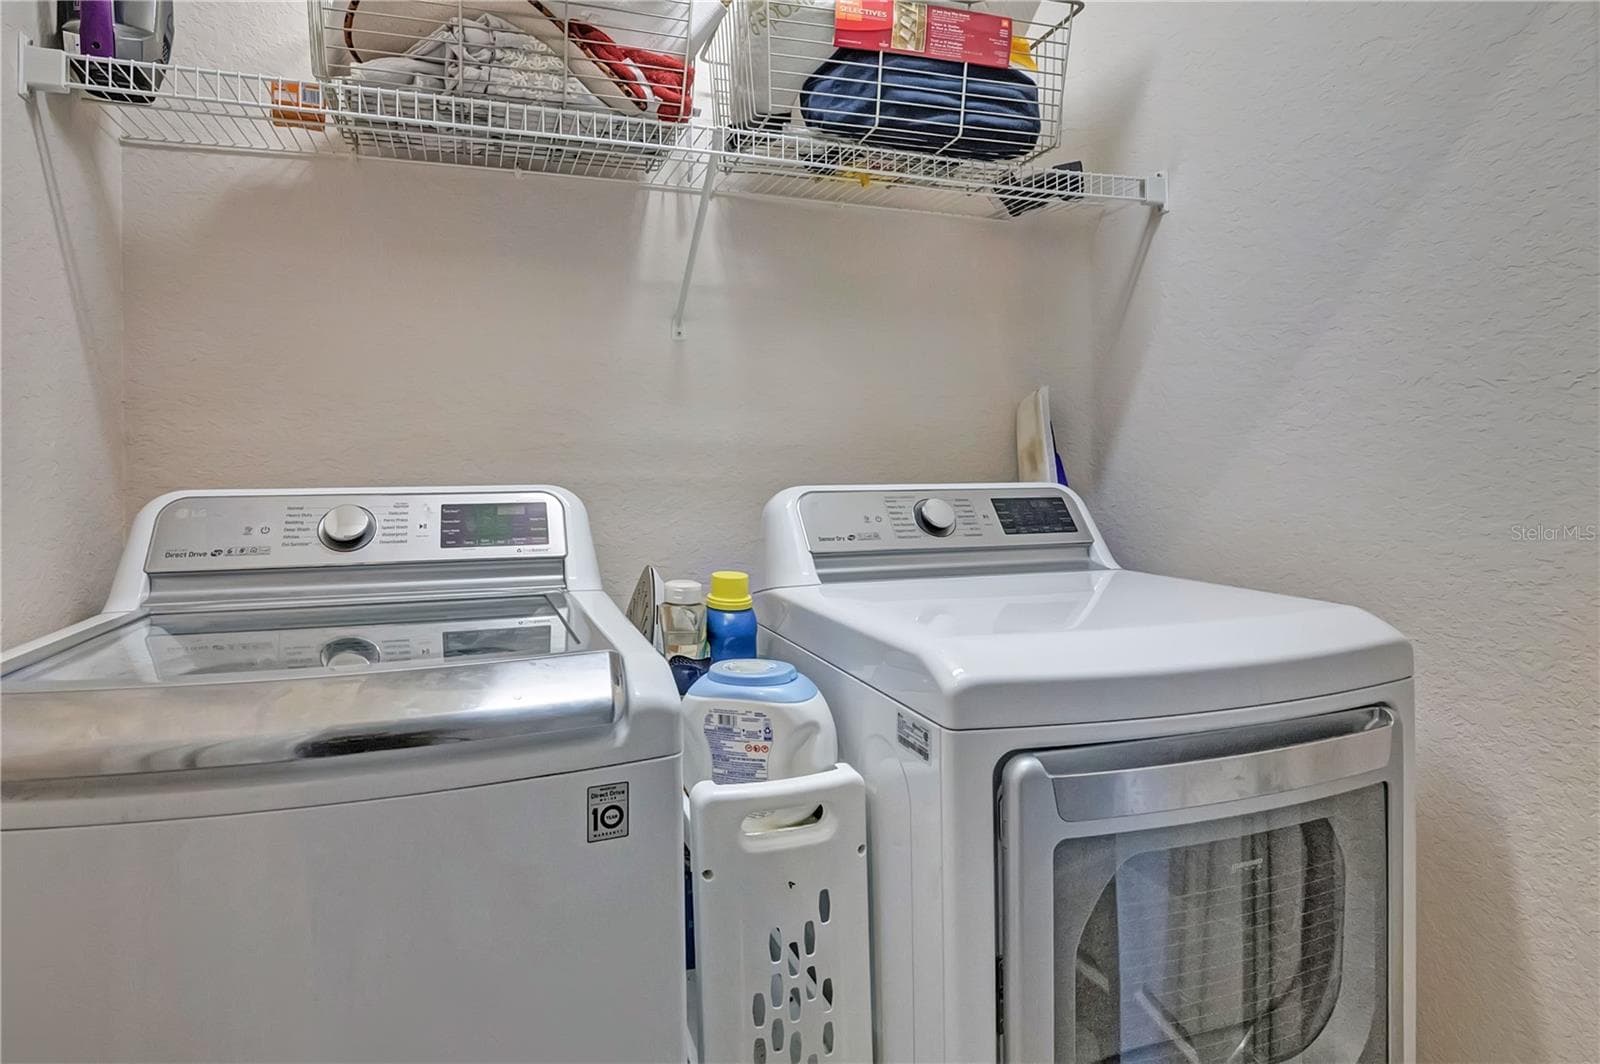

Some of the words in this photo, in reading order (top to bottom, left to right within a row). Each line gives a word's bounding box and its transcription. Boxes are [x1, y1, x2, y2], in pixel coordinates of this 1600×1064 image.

[840, 6, 888, 18] SELECTIVES
[164, 551, 187, 559] Direct
[188, 550, 208, 558] Drive
[592, 804, 624, 831] 10
